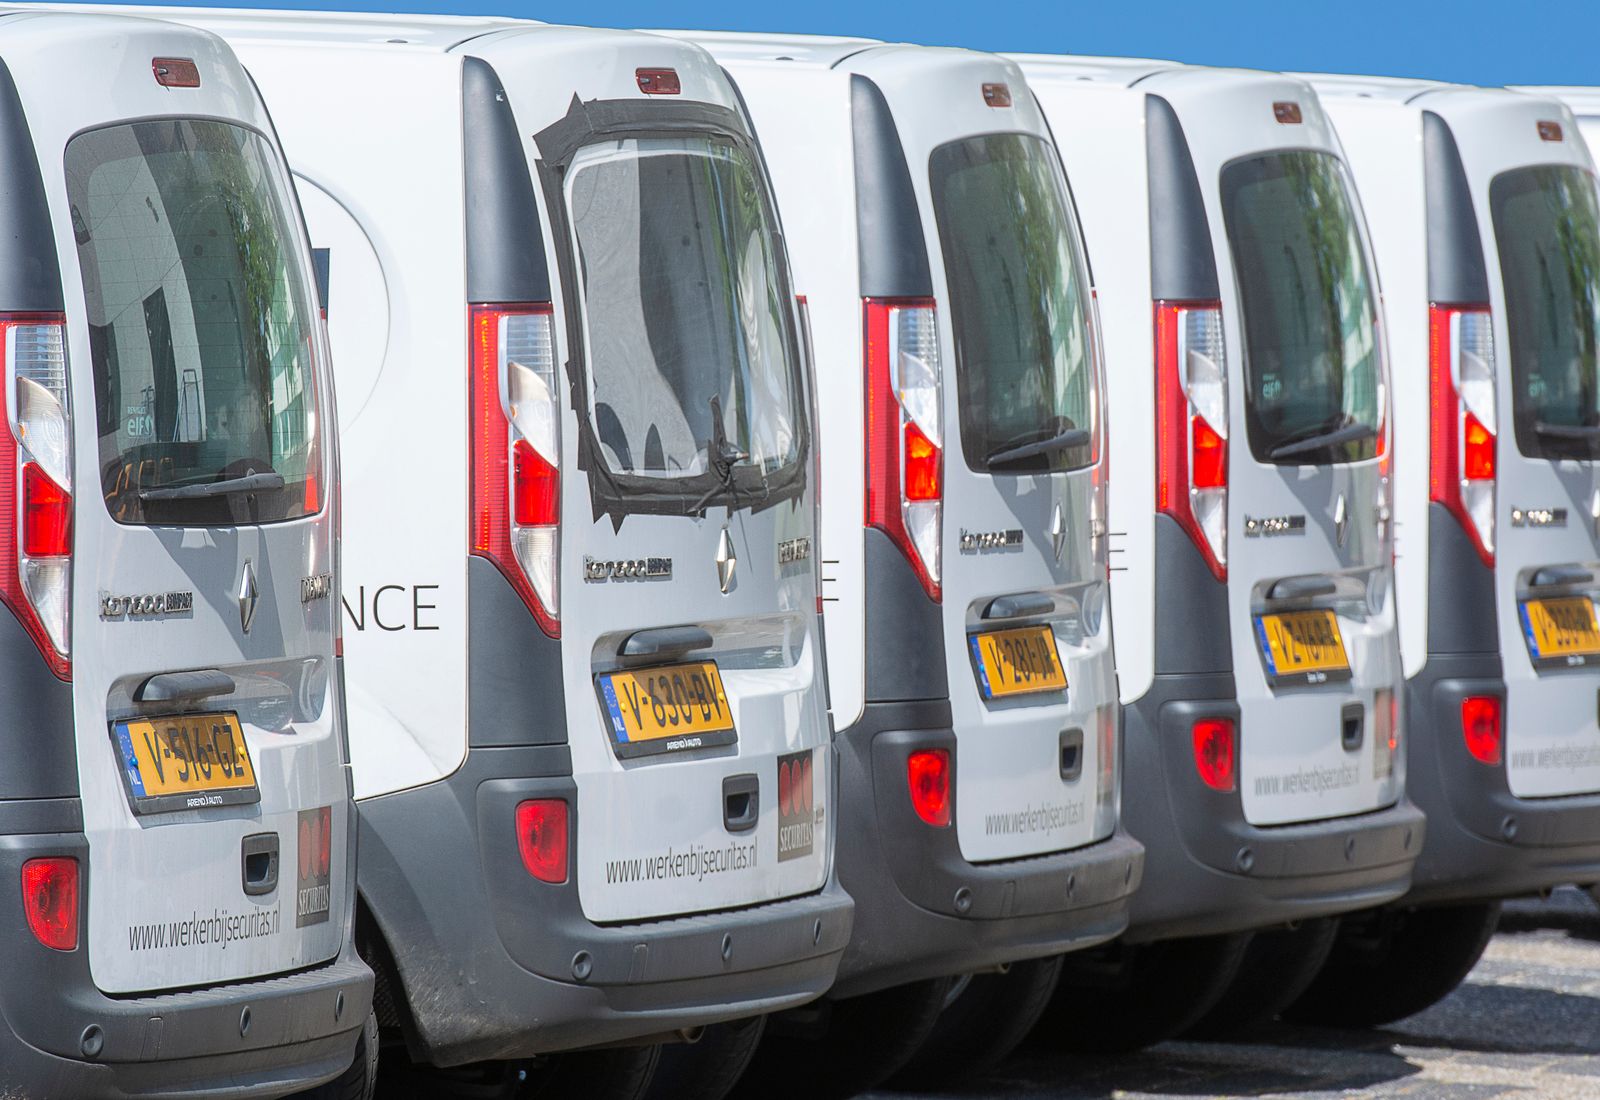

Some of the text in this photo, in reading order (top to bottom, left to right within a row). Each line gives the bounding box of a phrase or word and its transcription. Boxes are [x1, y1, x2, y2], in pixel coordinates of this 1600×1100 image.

[622, 672, 722, 730] V-630-BV
[612, 716, 625, 732] NL
[143, 723, 245, 786] V-516-GZ
[127, 769, 141, 786] NL
[780, 821, 813, 853] SECURITAS
[606, 837, 758, 884] www.werkenbijsecuritas.nl
[298, 884, 330, 916] SECURITAS
[129, 899, 281, 951] www.werkenbijsecuritas.nl
